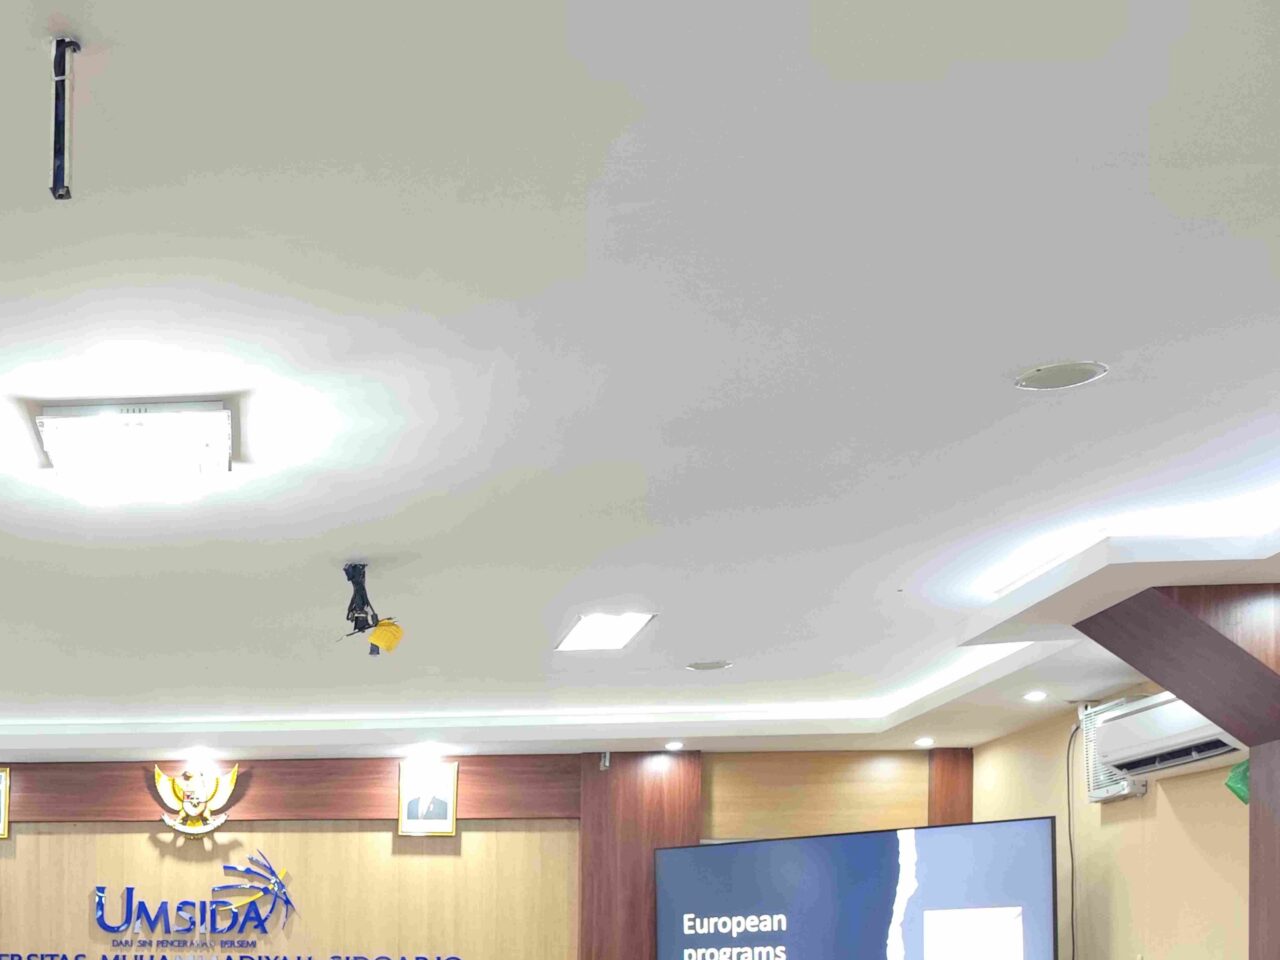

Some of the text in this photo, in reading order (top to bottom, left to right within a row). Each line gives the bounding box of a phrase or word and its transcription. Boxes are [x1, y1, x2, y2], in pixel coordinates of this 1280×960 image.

[683, 912, 787, 938] European
[112, 940, 133, 948] DARI
[137, 940, 153, 948] SINI
[220, 940, 257, 948] BERSEMI
